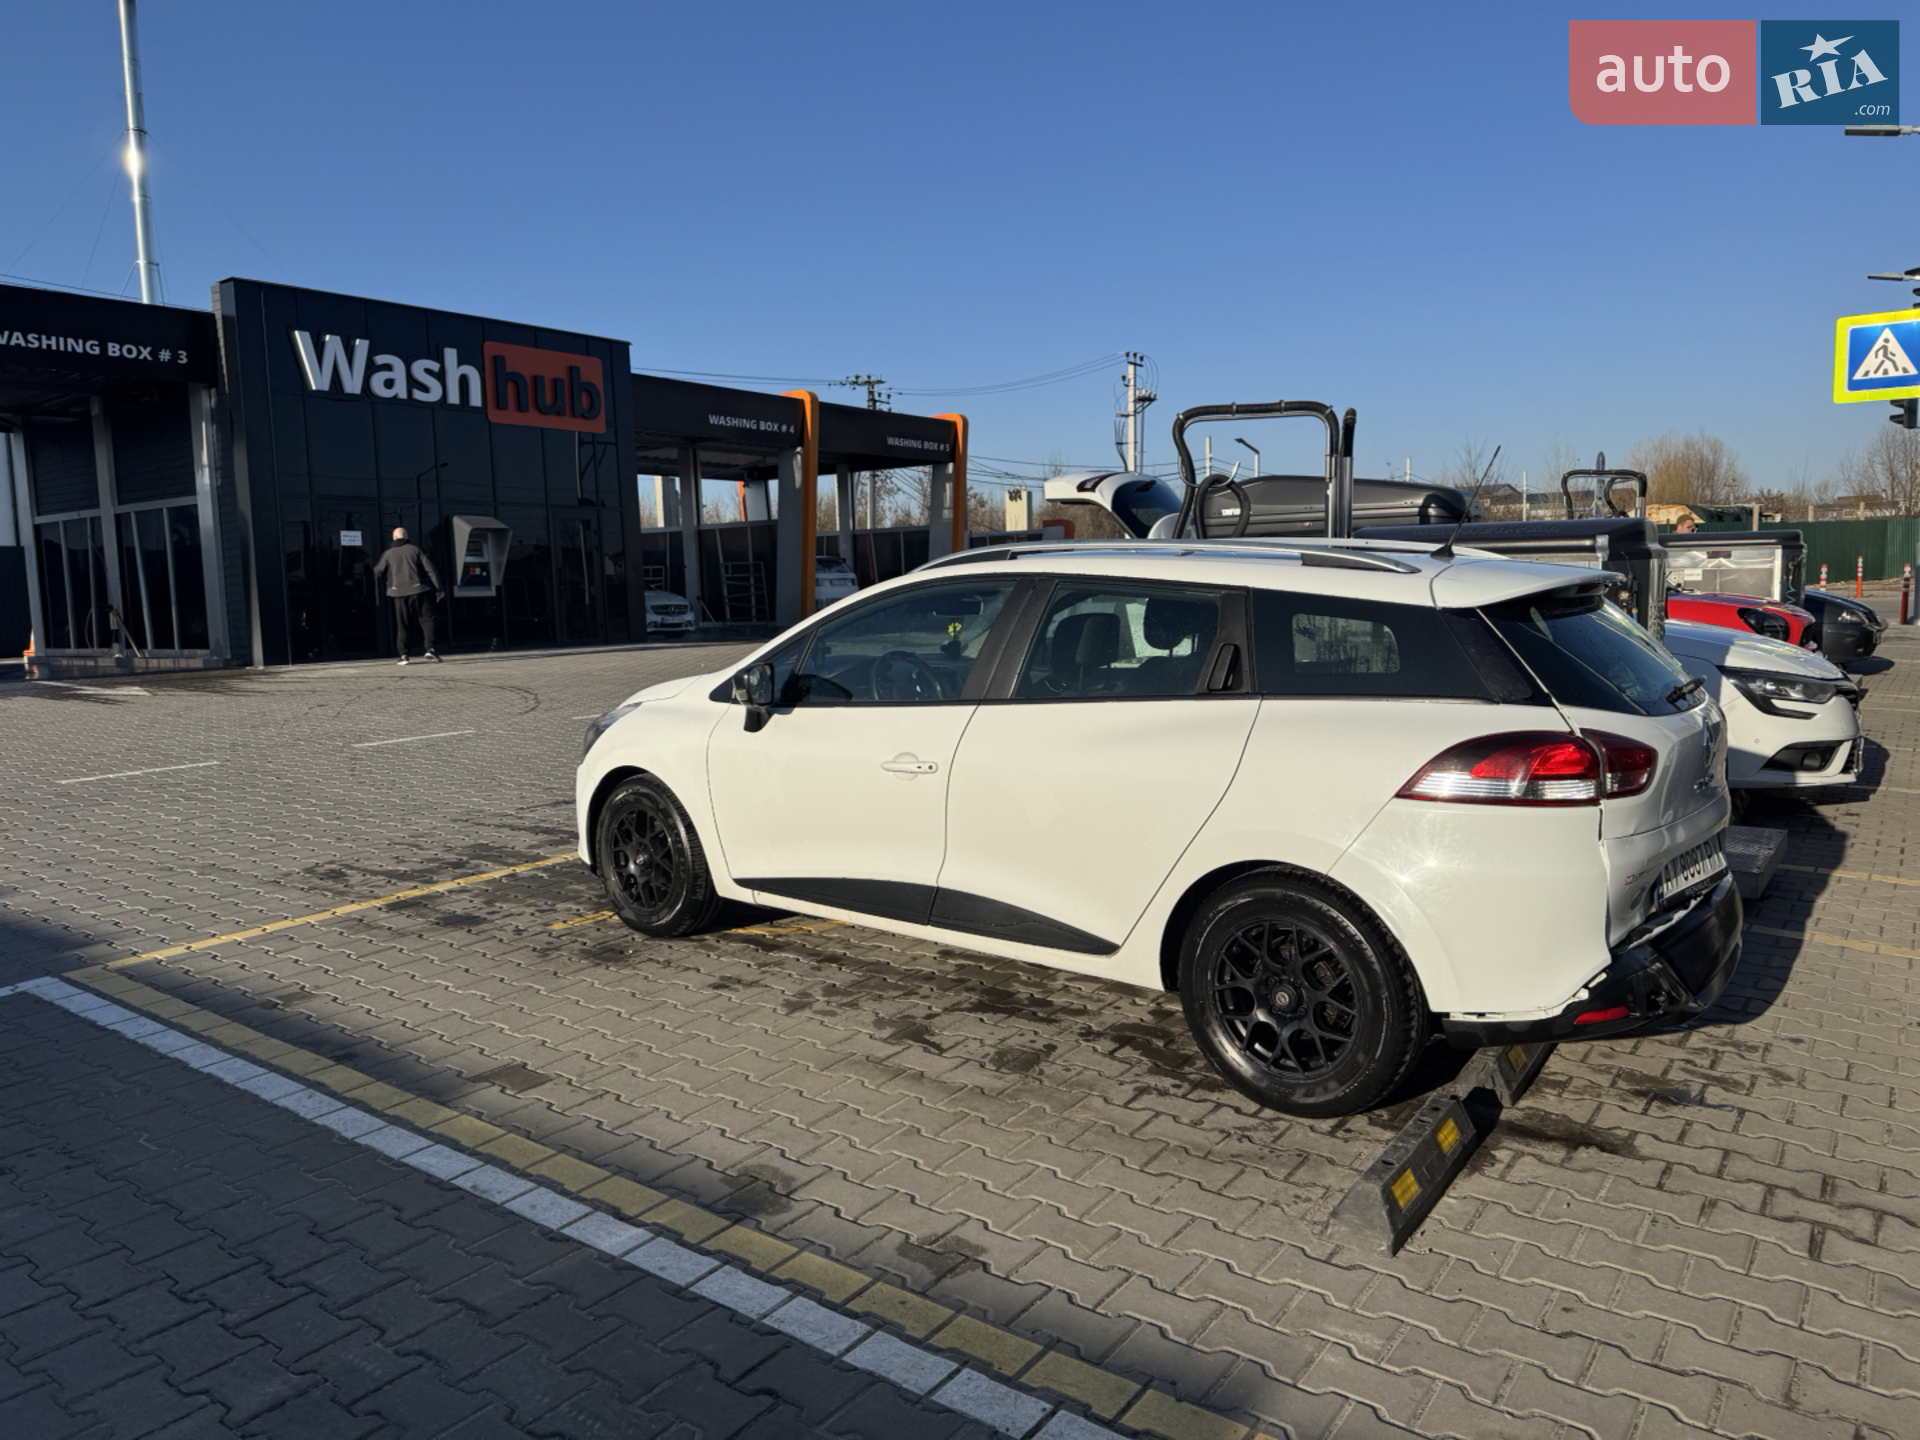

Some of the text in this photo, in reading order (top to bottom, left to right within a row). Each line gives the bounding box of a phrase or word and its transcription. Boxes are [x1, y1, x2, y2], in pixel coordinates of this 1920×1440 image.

[107, 342, 153, 361] BOX
[158, 349, 172, 362] #
[177, 351, 188, 364] 3
[708, 414, 757, 430] WASHING
[759, 420, 780, 432] BOX
[789, 425, 795, 433] 4
[887, 436, 922, 449] WASHING
[924, 440, 939, 450] BOX
